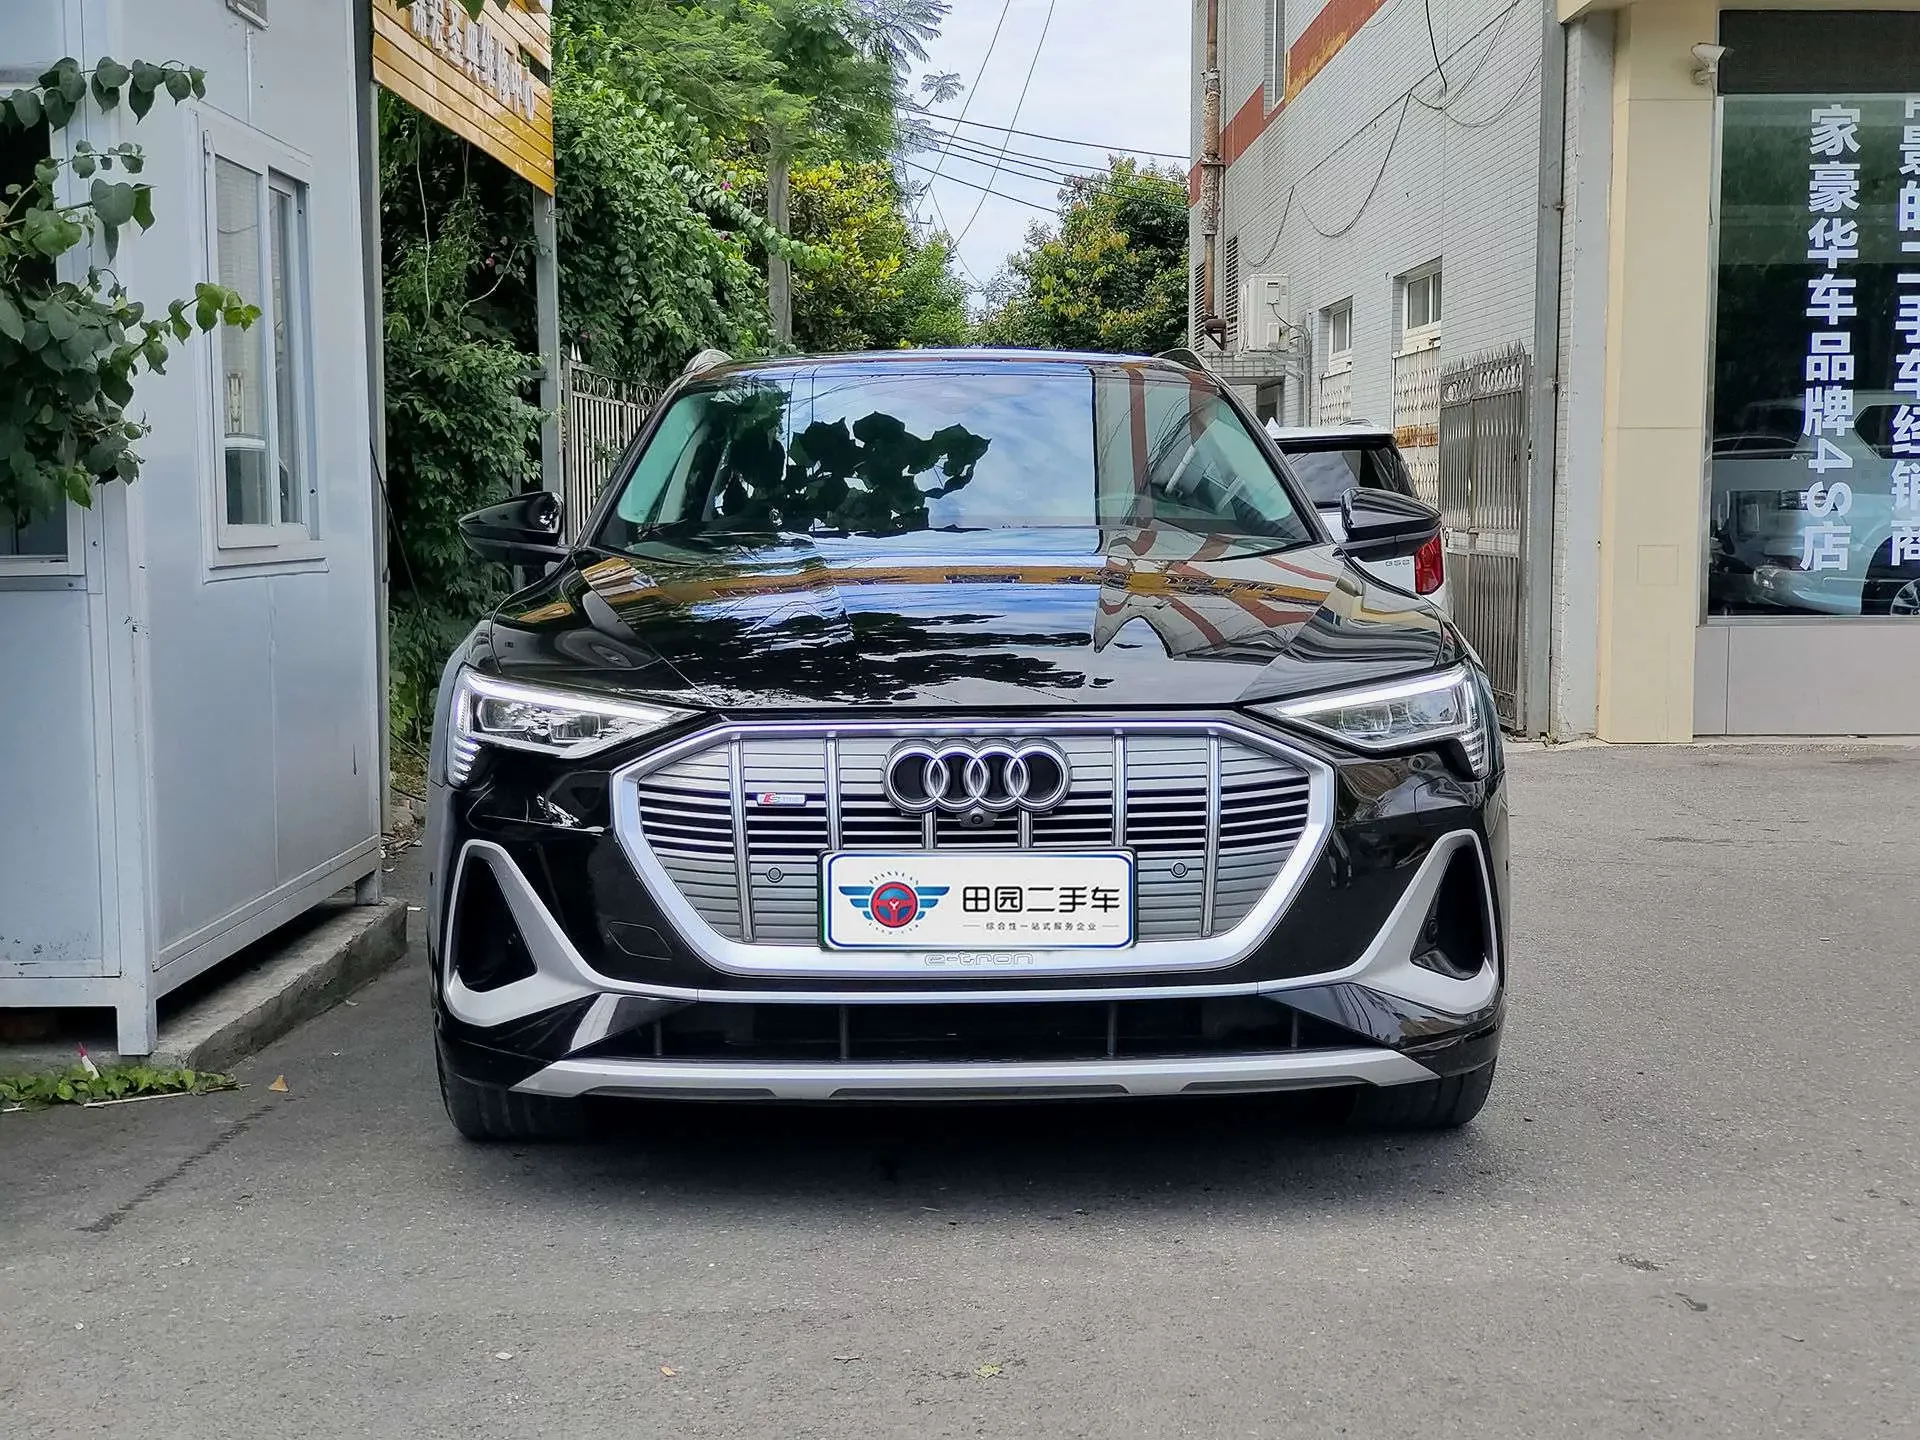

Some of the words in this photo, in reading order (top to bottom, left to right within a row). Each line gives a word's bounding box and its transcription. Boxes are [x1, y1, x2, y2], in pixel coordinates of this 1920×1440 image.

[1800, 103, 1861, 571] 家豪华车品牌4S店
[963, 886, 1120, 912] 田园二手车
[924, 951, 1034, 966] e-tron
